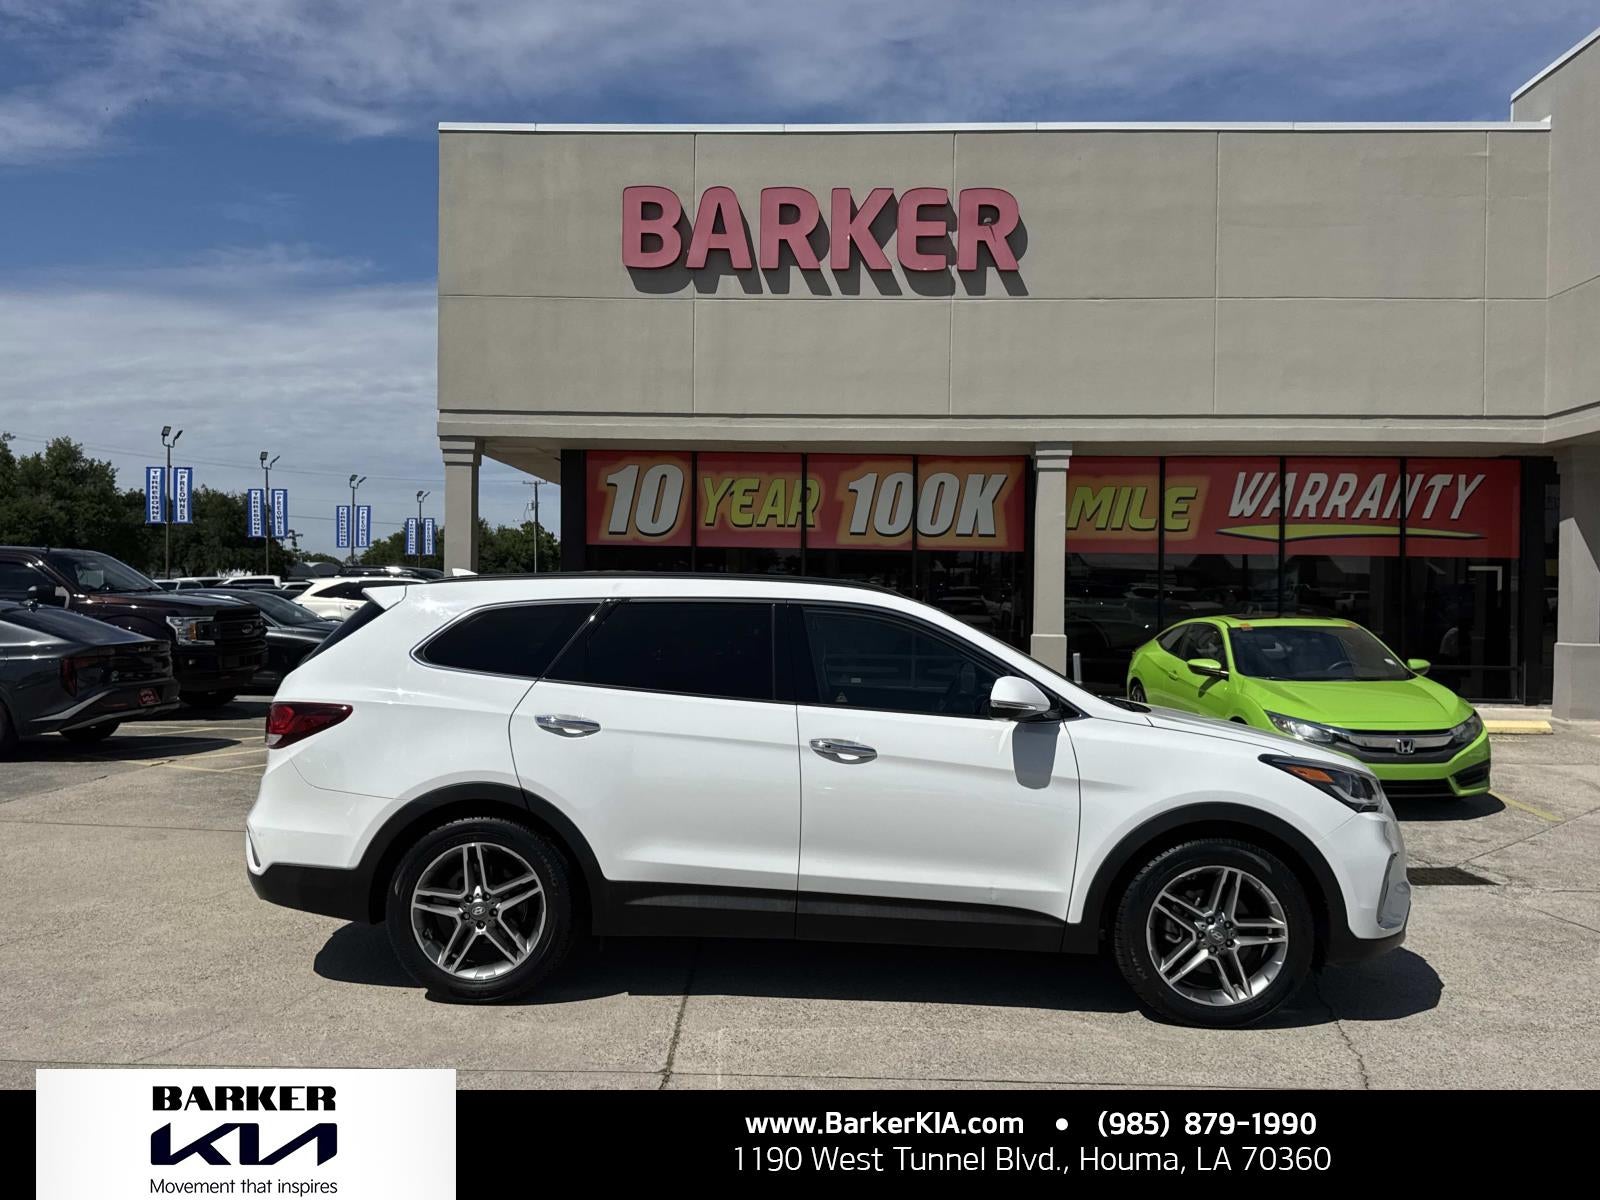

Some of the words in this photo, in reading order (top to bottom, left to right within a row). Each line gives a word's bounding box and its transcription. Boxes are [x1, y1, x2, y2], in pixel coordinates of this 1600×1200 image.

[622, 185, 1020, 272] BARKER
[151, 470, 160, 520] TERREBONNE
[179, 475, 187, 520] PREOWNED
[606, 464, 685, 537] 10
[703, 476, 820, 528] YEAR
[848, 472, 1008, 537] 100K
[1066, 485, 1199, 532] MILE
[1228, 471, 1487, 520] WARRANTY
